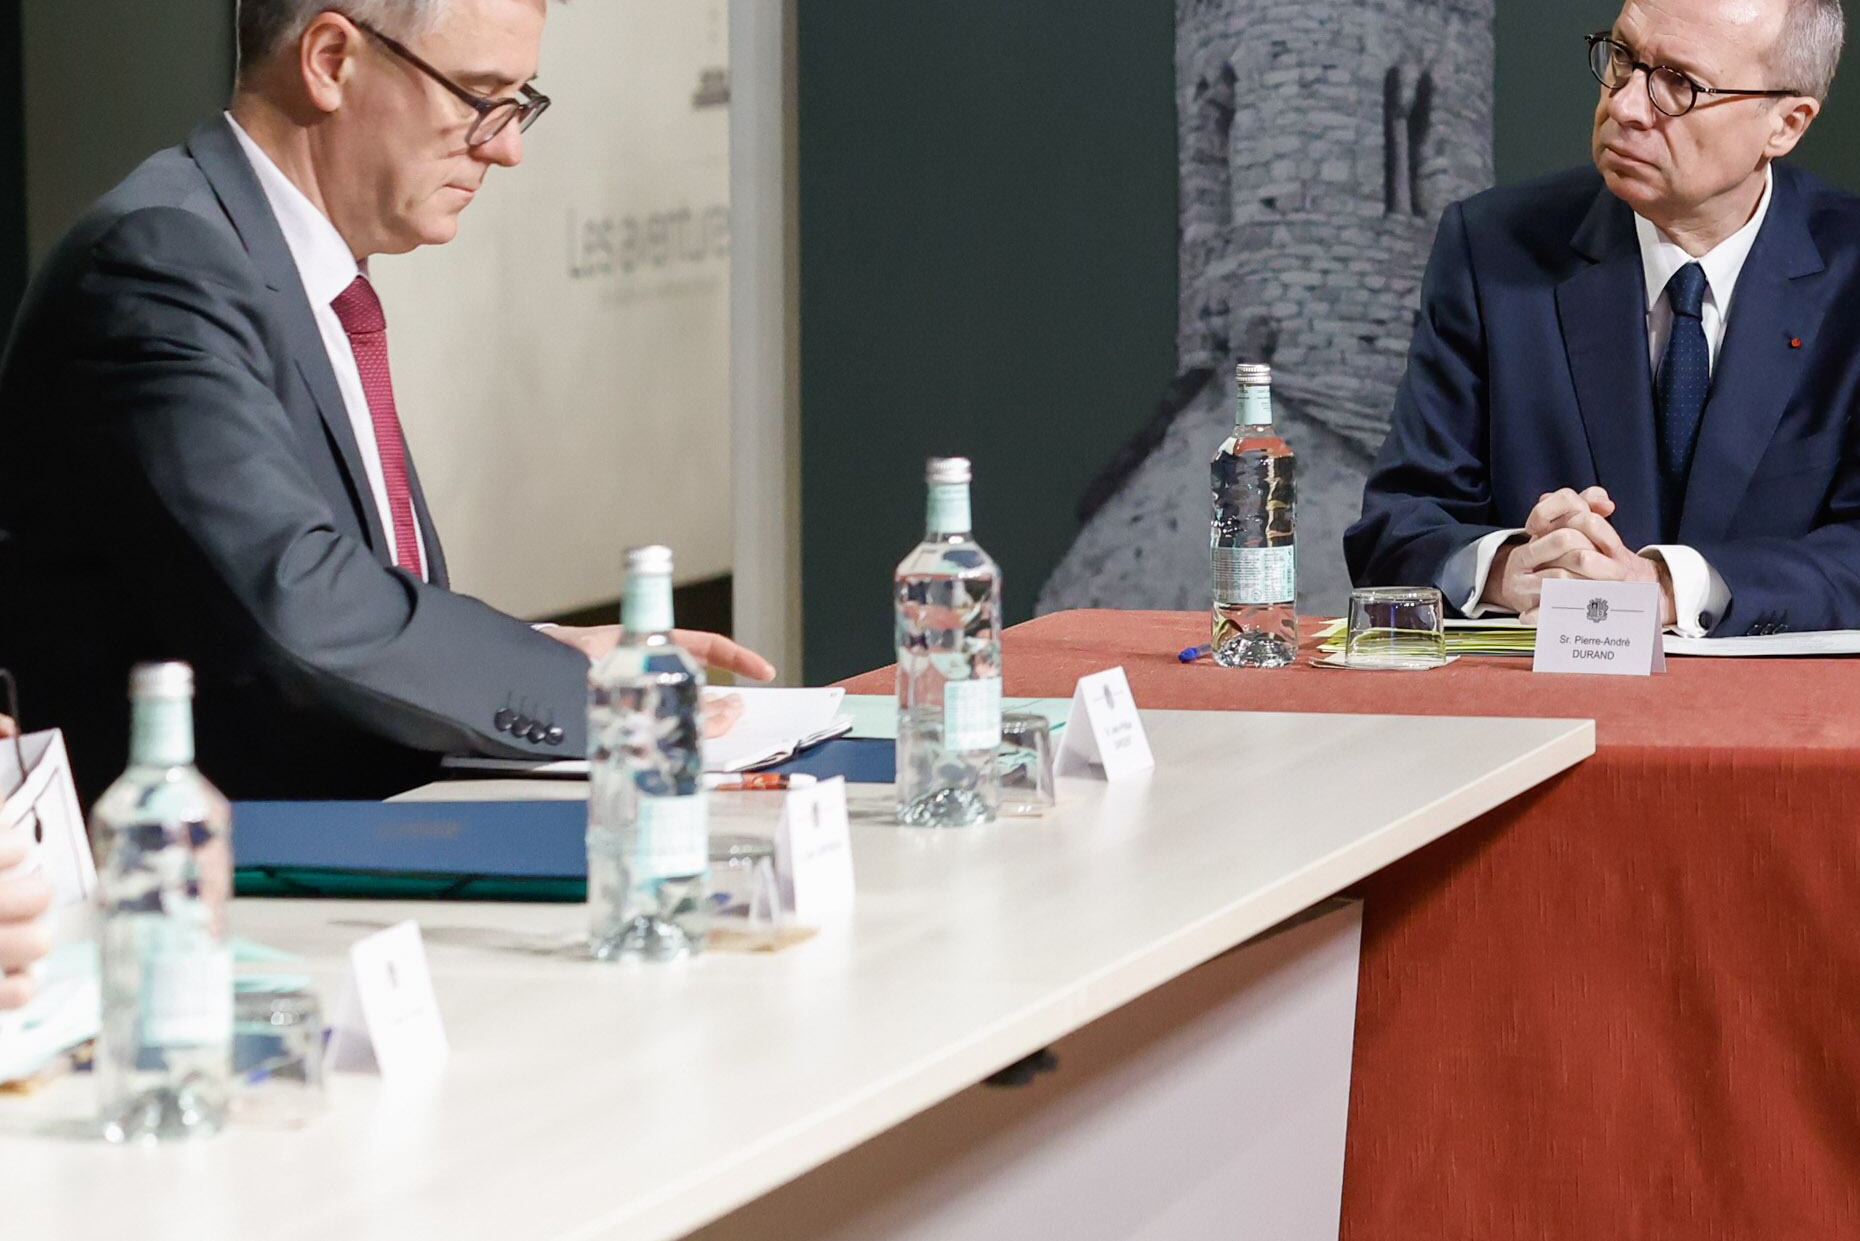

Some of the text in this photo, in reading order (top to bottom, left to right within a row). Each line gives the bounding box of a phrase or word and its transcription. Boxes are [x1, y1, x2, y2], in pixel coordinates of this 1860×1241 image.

[1559, 634, 1631, 647] Sr. Pierre-André
[1571, 649, 1615, 661] DURAND
